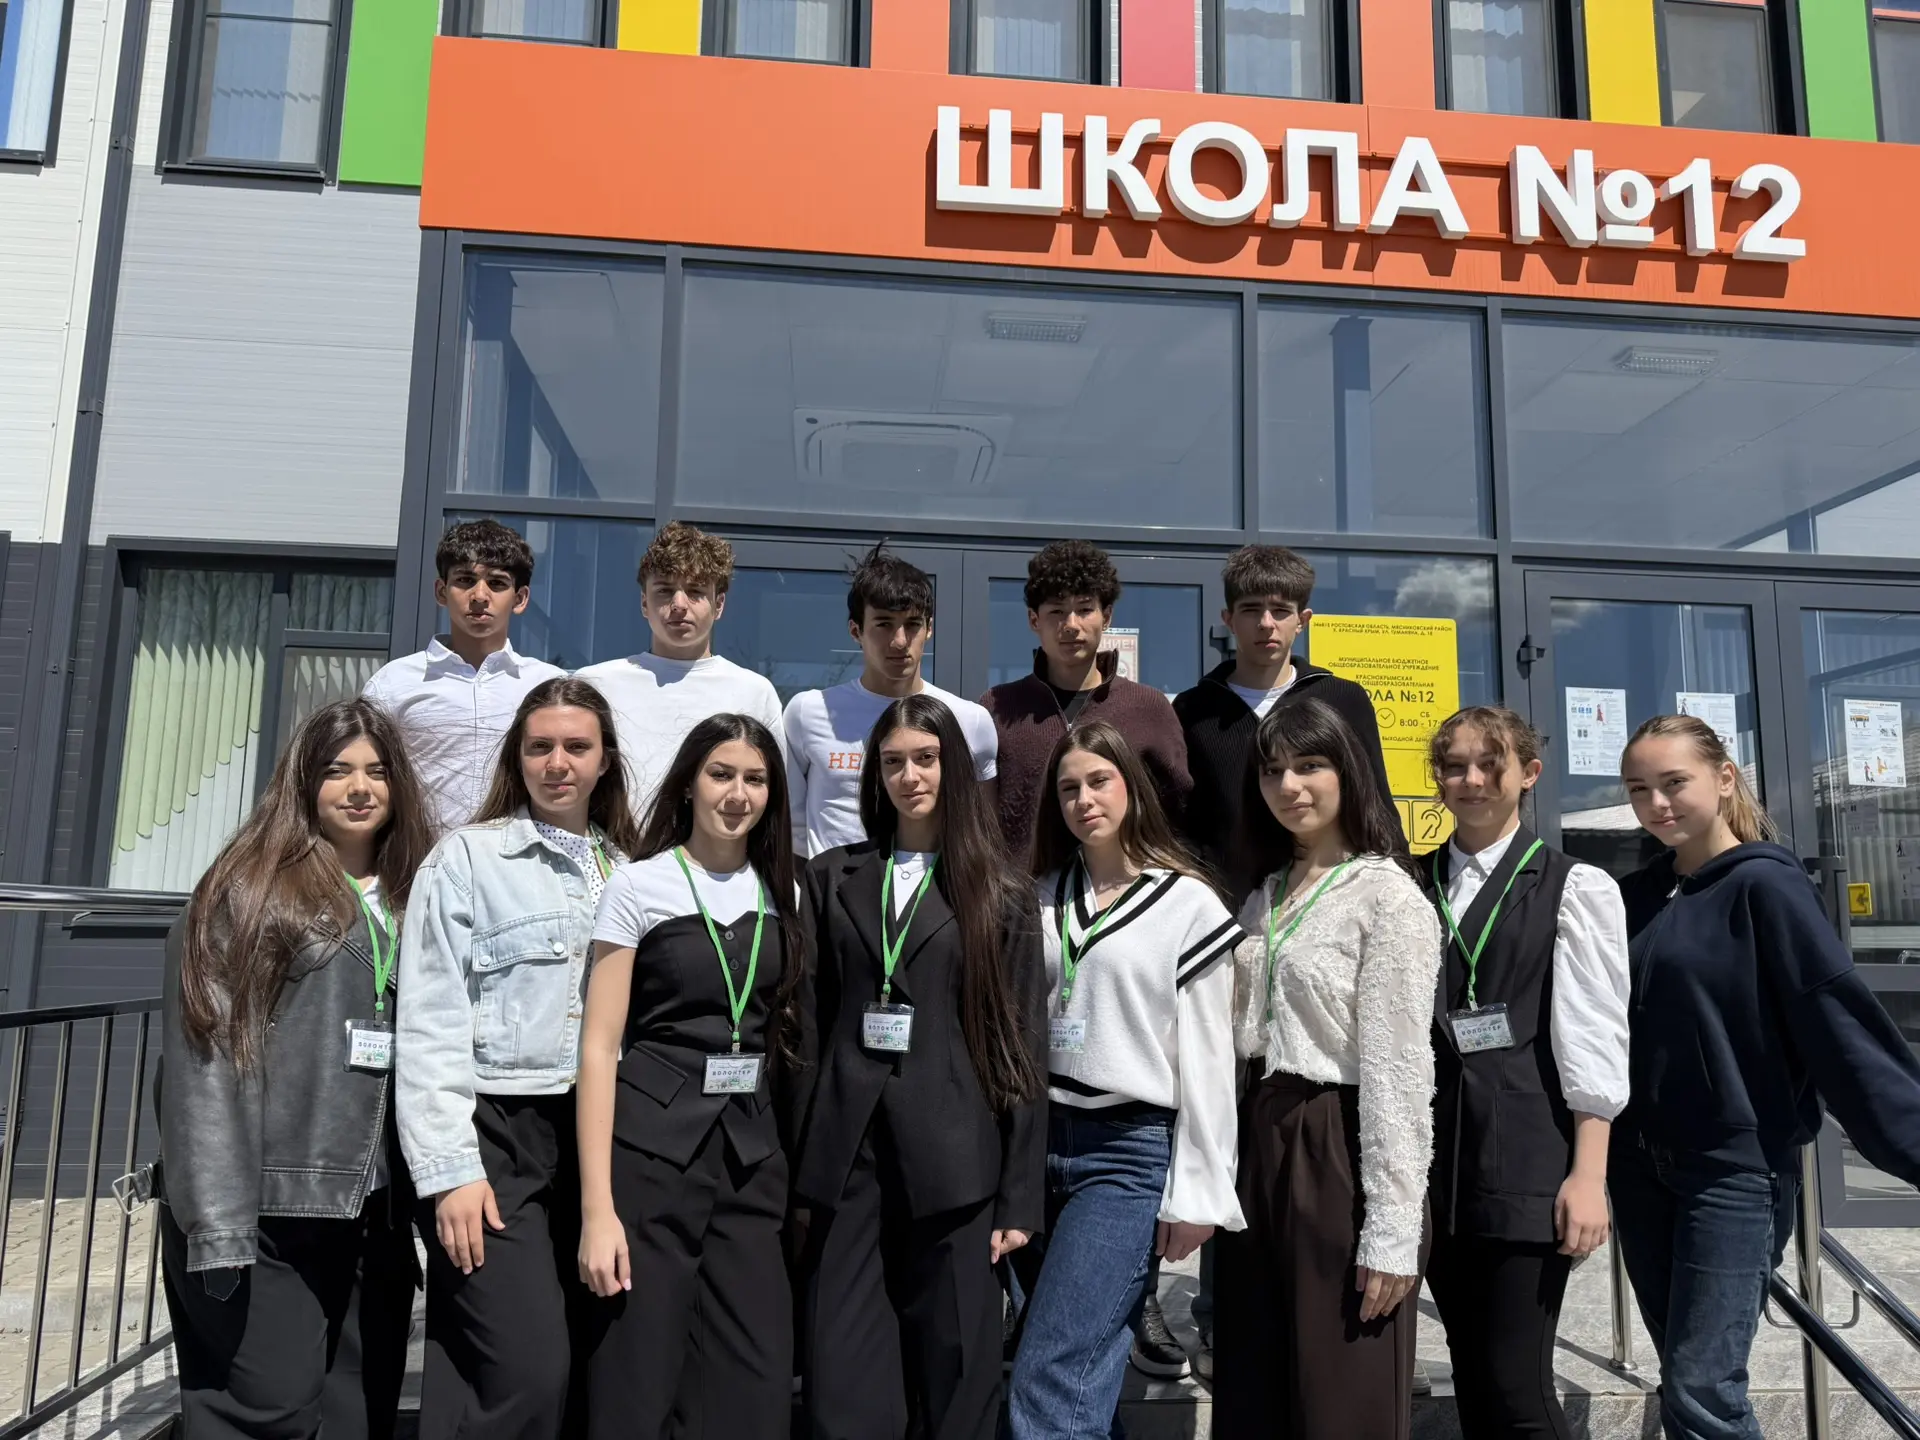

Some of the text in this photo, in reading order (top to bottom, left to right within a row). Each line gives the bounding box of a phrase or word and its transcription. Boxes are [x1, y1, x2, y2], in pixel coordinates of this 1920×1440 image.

[935, 105, 1807, 263] ШКОЛА №12
[1328, 662, 1401, 670] ОБЩЕОБРАЗОВАТЕЛЬНОЕ
[1362, 680, 1434, 688] ОБЩЕОБРАЗОВАТЕЛЬНАЯ
[1400, 690, 1435, 703] №12
[1399, 718, 1419, 727] 8:00
